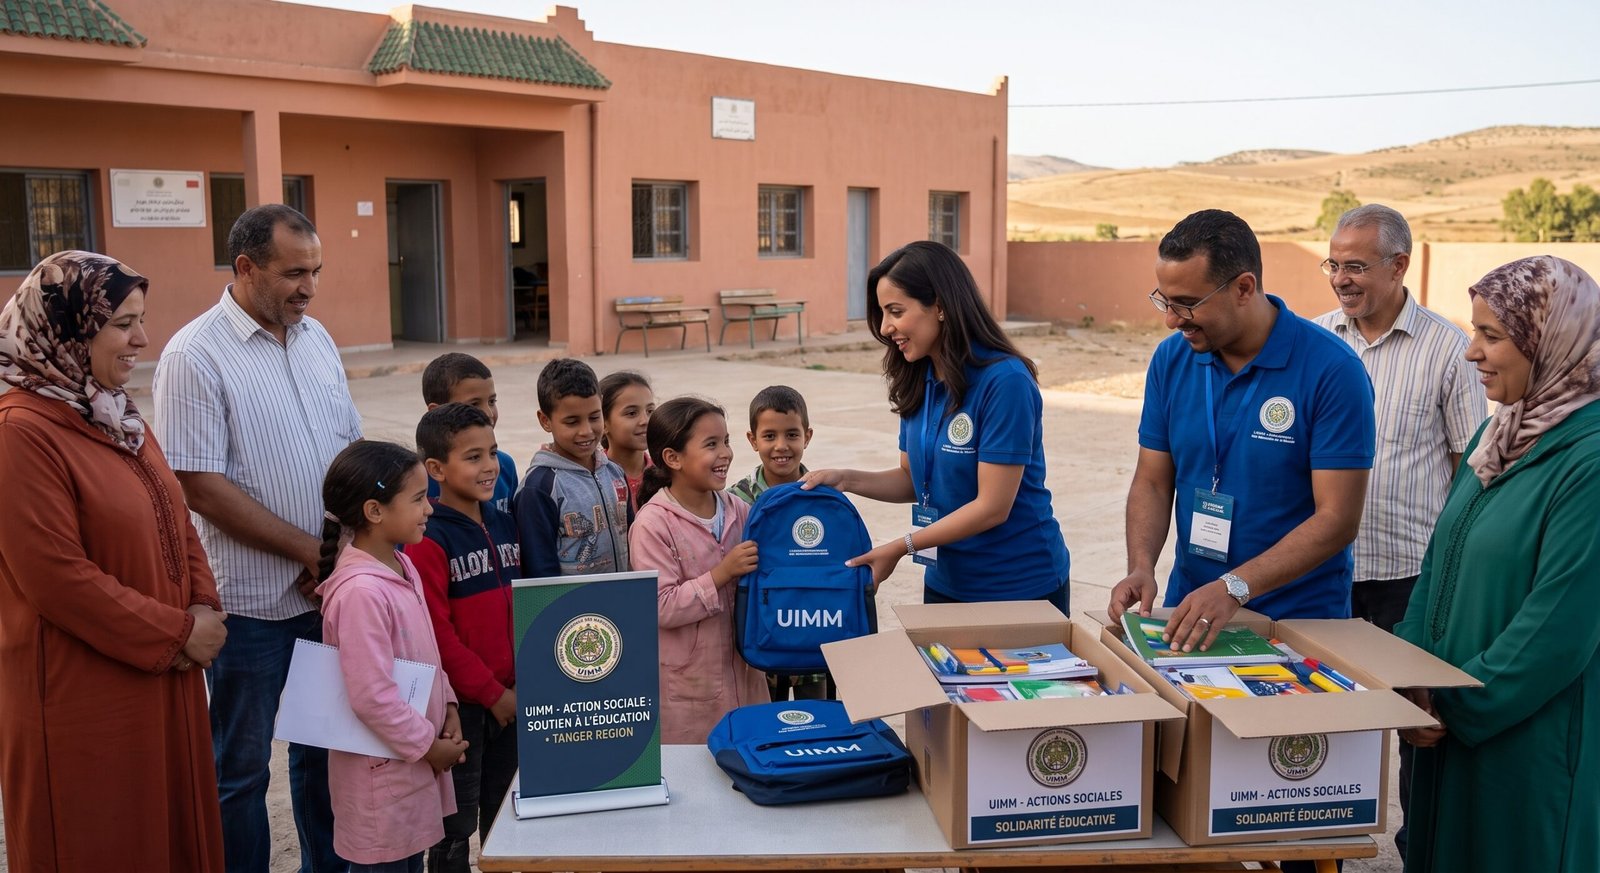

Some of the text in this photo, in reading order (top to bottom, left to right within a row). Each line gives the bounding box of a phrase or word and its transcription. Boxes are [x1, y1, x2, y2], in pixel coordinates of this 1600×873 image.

[777, 609, 842, 628] UIMM
[577, 666, 602, 676] UIMM
[525, 705, 553, 717] UIMM
[563, 701, 601, 714] ACTION
[603, 697, 646, 710] SOCIALE
[527, 711, 650, 732] SOUTIEN À L'ÉDUCATION
[552, 727, 634, 744] TANGER REGION
[785, 743, 862, 757] UIMM
[1046, 774, 1068, 782] UIMM
[1286, 767, 1308, 775] UIMM
[989, 798, 1017, 809] UIMM
[1026, 794, 1071, 808] ACTIONS
[1073, 790, 1123, 804] SOCIALES
[1230, 790, 1258, 802] UIMM
[1267, 787, 1311, 800] ACTIONS
[1313, 783, 1361, 796] SOCIALES
[995, 813, 1116, 833] SOLIDARITÉ ÉDUCATIVE
[1236, 807, 1354, 825] SOLIDARITÉ ÉDUCATIVE
